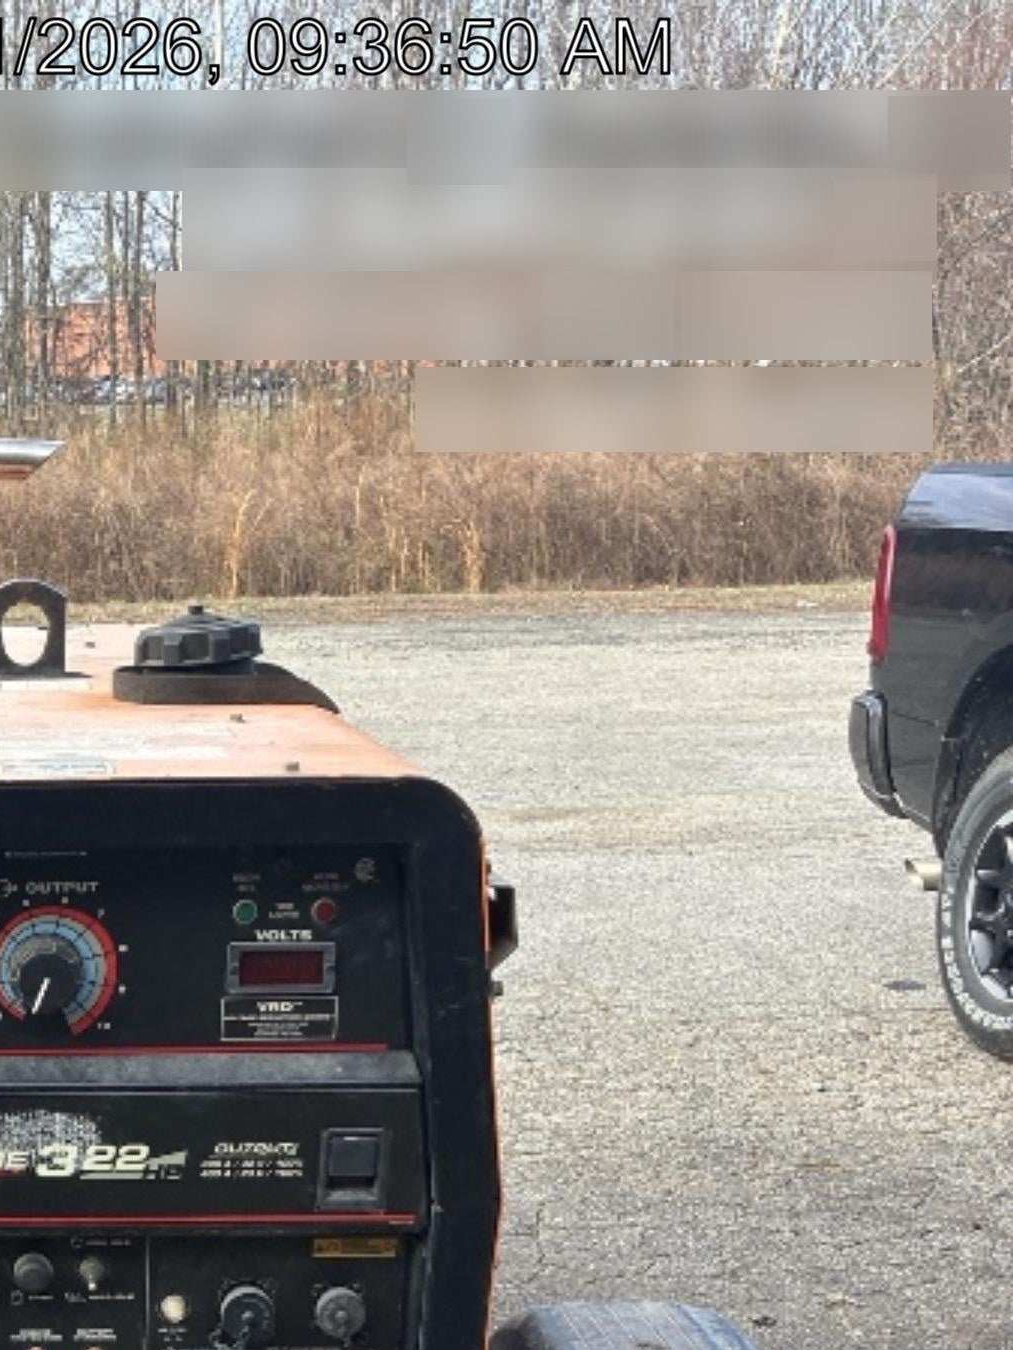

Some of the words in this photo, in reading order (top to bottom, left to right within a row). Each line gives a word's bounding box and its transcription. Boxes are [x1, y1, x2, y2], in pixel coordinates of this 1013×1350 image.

[25, 881, 99, 894] OUTPUT
[254, 929, 313, 941] VOLTS
[36, 1143, 150, 1177] 322
